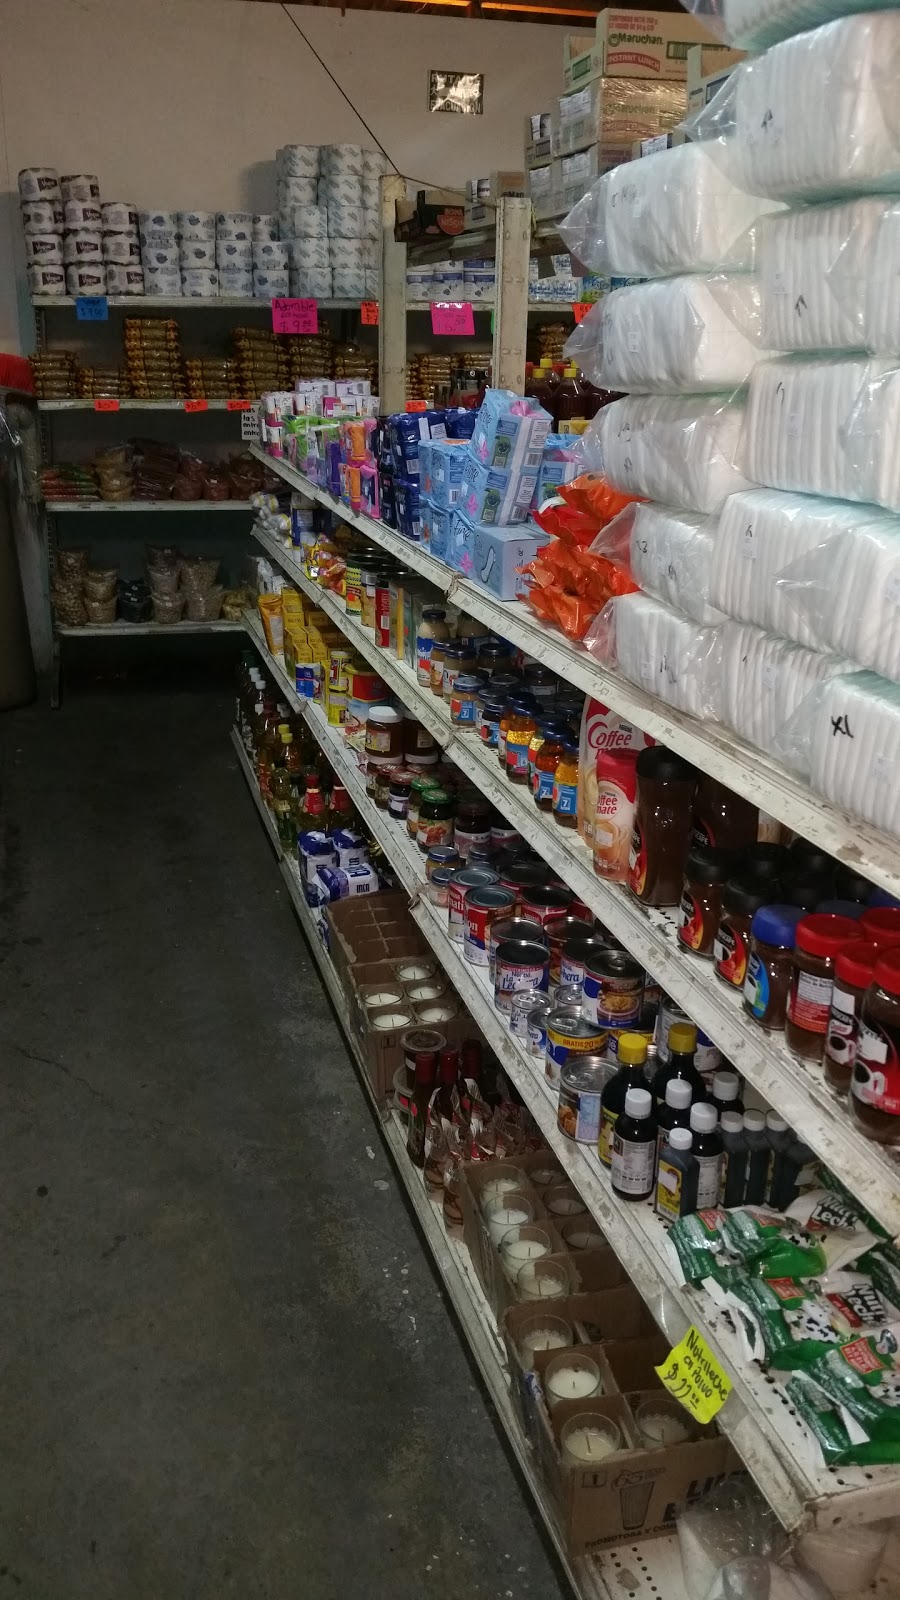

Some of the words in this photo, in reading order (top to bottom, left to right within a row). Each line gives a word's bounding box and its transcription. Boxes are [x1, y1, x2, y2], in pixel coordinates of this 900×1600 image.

[618, 32, 662, 46] Maruchan
[637, 55, 660, 69] LUNCH
[587, 721, 632, 749] Coffee
[562, 1038, 584, 1048] GRATIS
